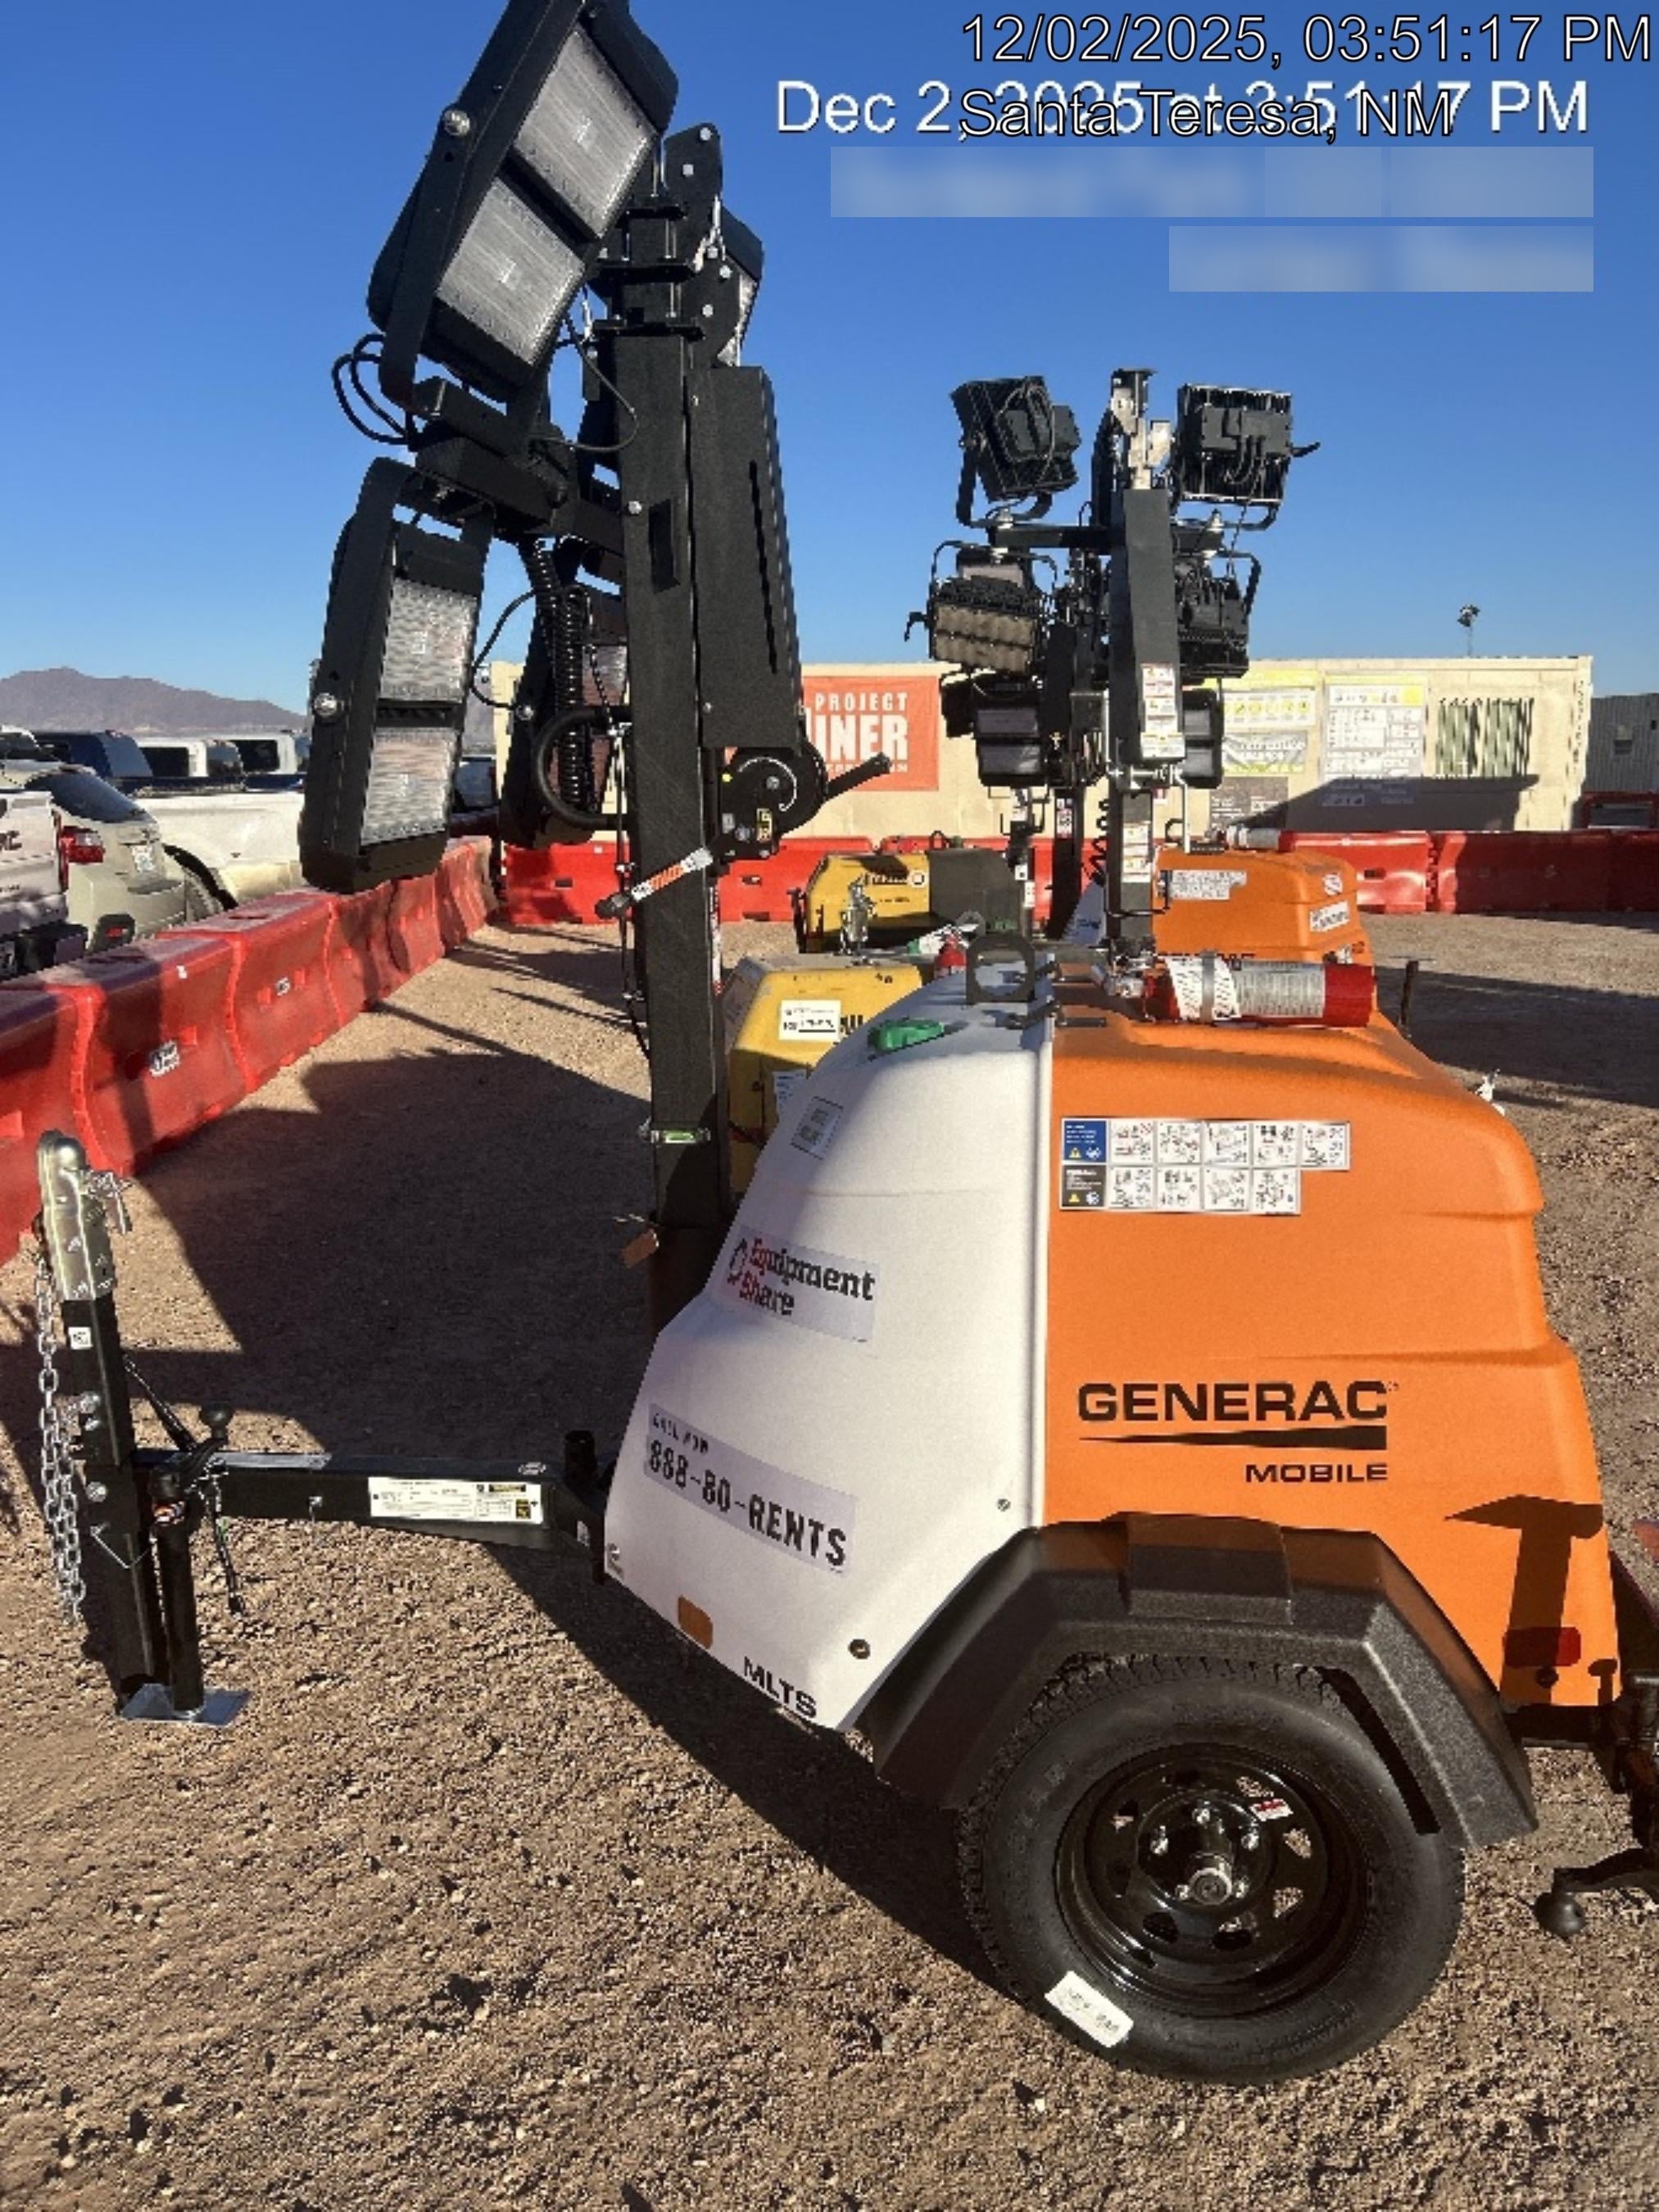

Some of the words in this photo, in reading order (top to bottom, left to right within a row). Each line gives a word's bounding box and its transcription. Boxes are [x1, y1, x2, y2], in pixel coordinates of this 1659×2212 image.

[814, 692, 909, 712] PROJECT
[750, 1238, 876, 1301] Equipment
[739, 1271, 795, 1316] Share
[1077, 1380, 1388, 1421] GENERAC
[1245, 1463, 1388, 1484] MOBILE
[649, 1439, 847, 1566] 888-80-RENTS
[744, 1656, 817, 1718] MLTS
